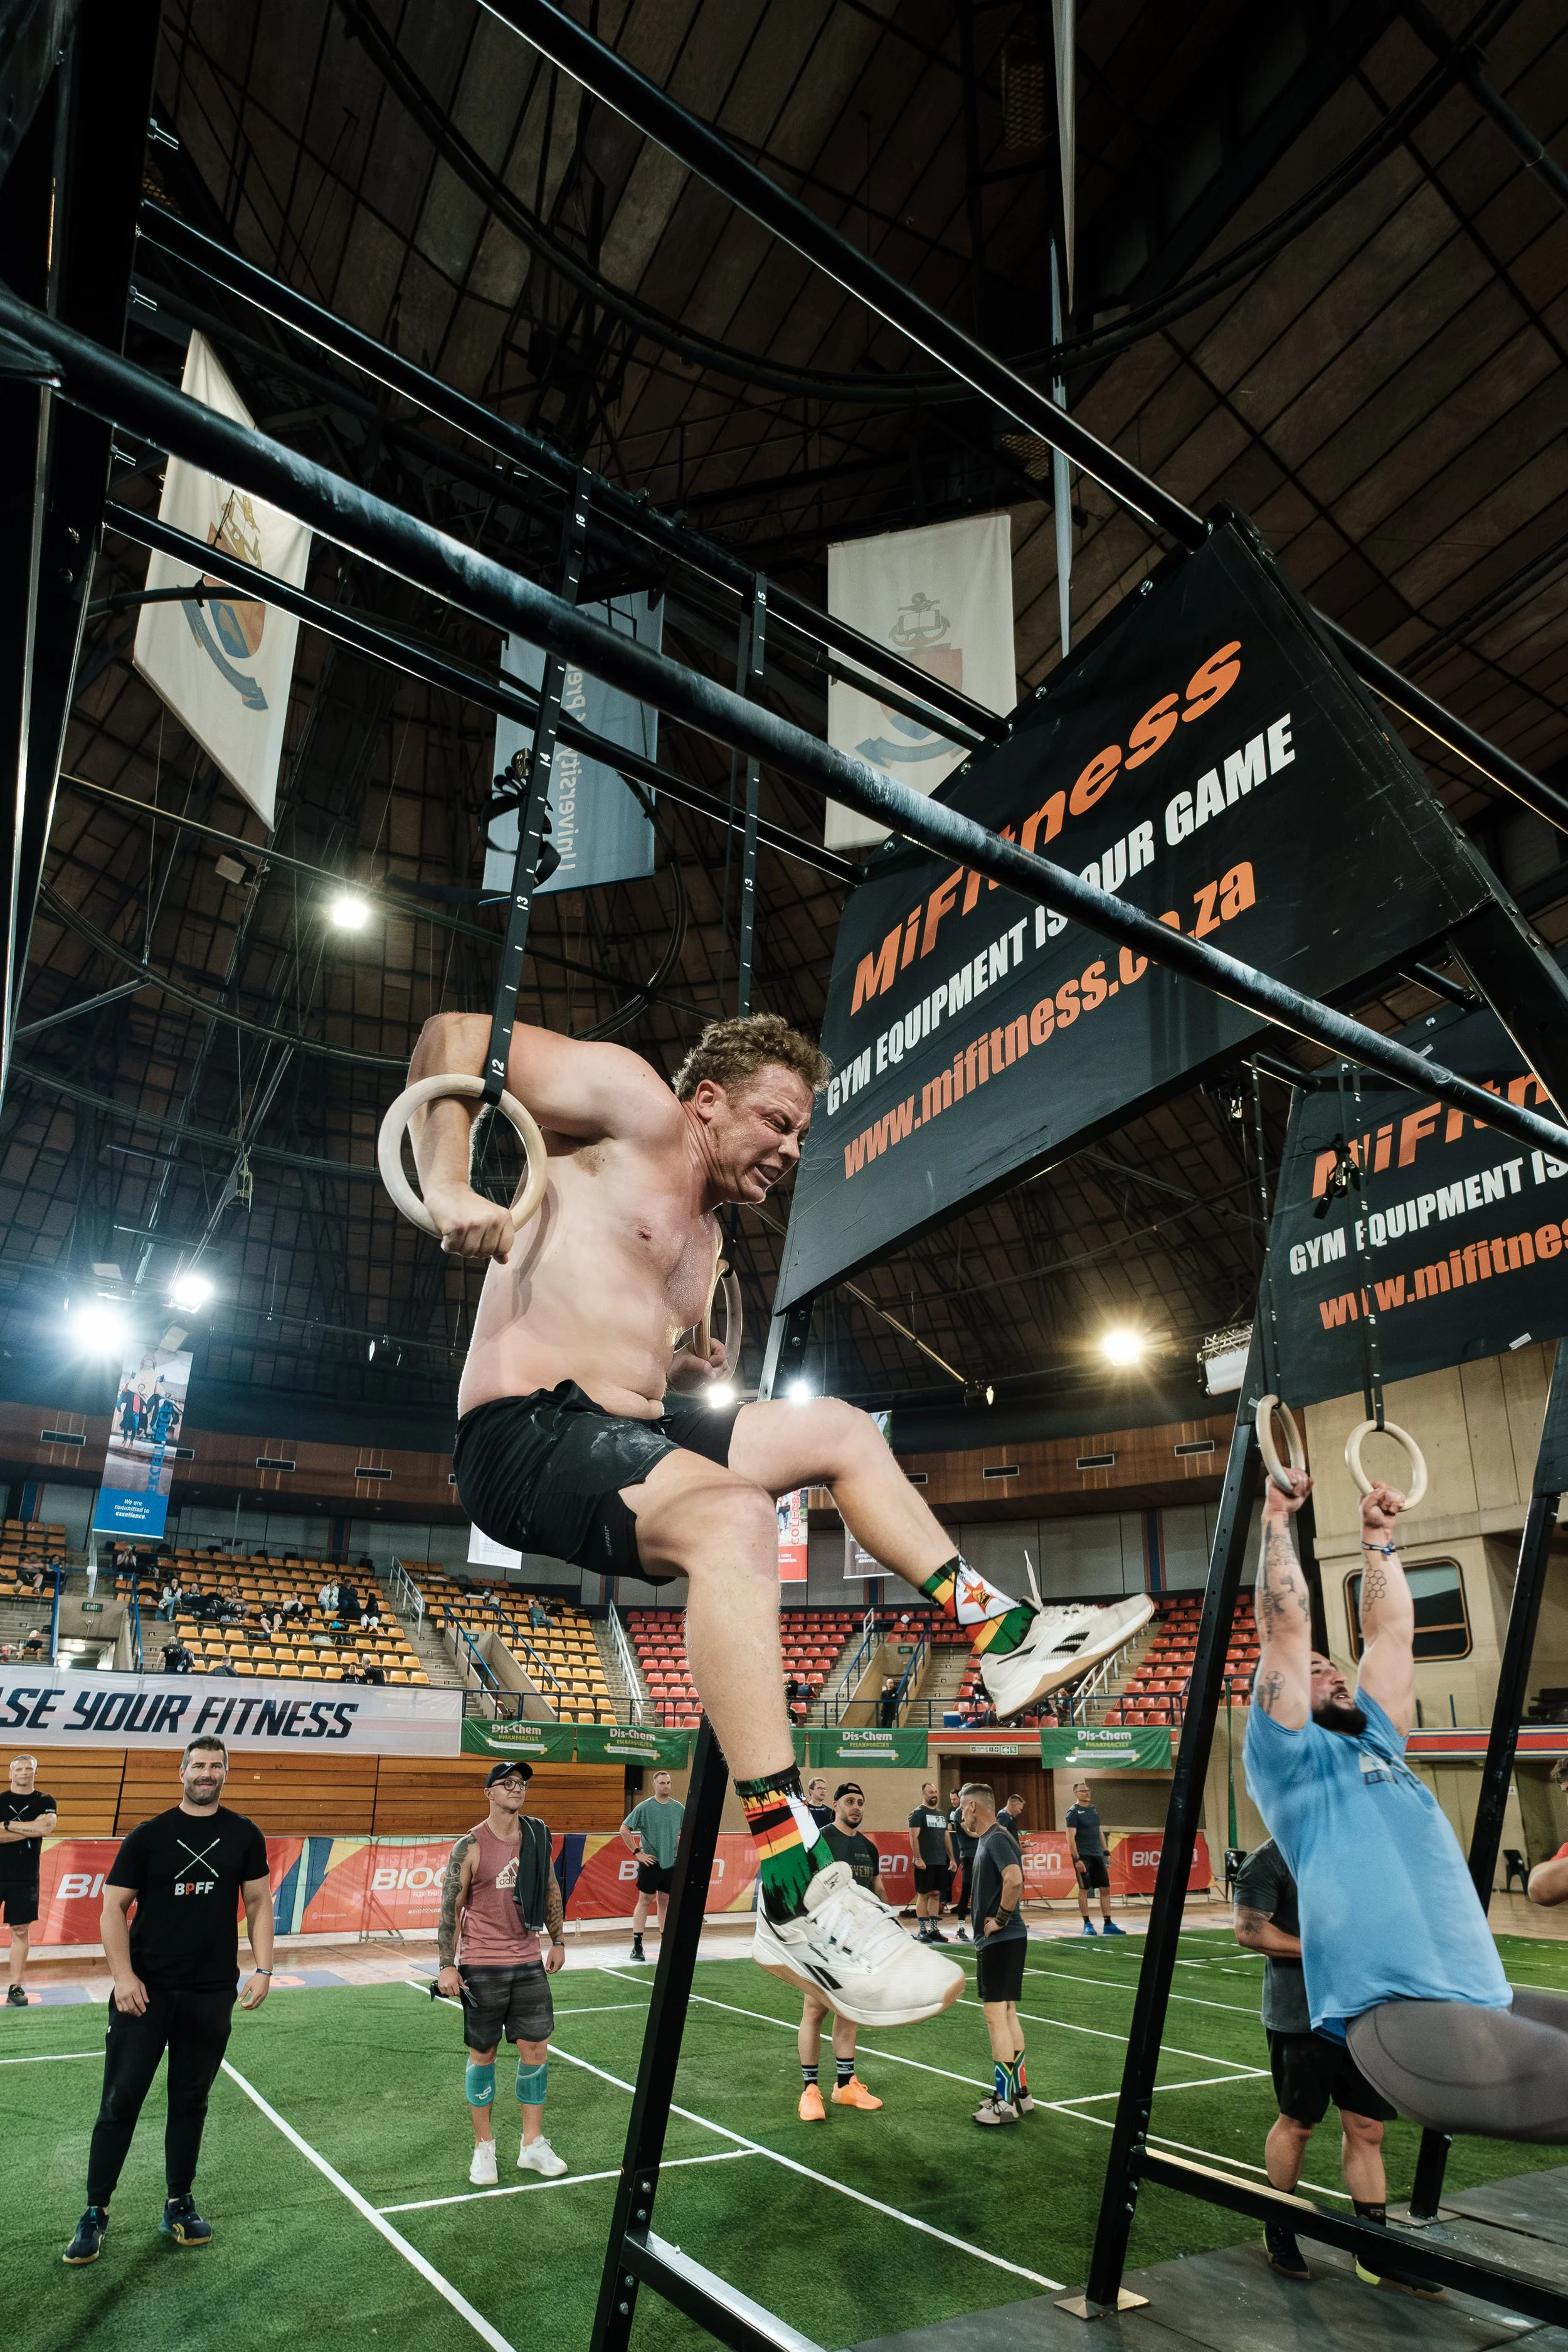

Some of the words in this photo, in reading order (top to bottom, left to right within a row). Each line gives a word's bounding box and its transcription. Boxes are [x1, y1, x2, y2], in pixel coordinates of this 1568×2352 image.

[516, 895, 529, 911] 13
[826, 1047, 871, 1116] GYM
[876, 917, 1028, 1076] EQUIPMENT
[1165, 712, 1296, 847] GAME
[843, 861, 1256, 1180] www.mifitness.cza
[492, 1059, 505, 1078] 12
[1290, 1227, 1347, 1276] GYM
[1354, 1157, 1524, 1251] EQUIPMENT
[0, 1687, 65, 1729] SE
[63, 1691, 193, 1733] YOUR
[191, 1696, 359, 1739] FITNESS
[491, 1724, 542, 1735] Dis-Chem
[610, 1728, 656, 1741] Dis-Chem
[842, 1731, 893, 1741] Dis-Chem
[1077, 1730, 1132, 1741] Dis-Chem
[174, 1882, 214, 1895] BPFF
